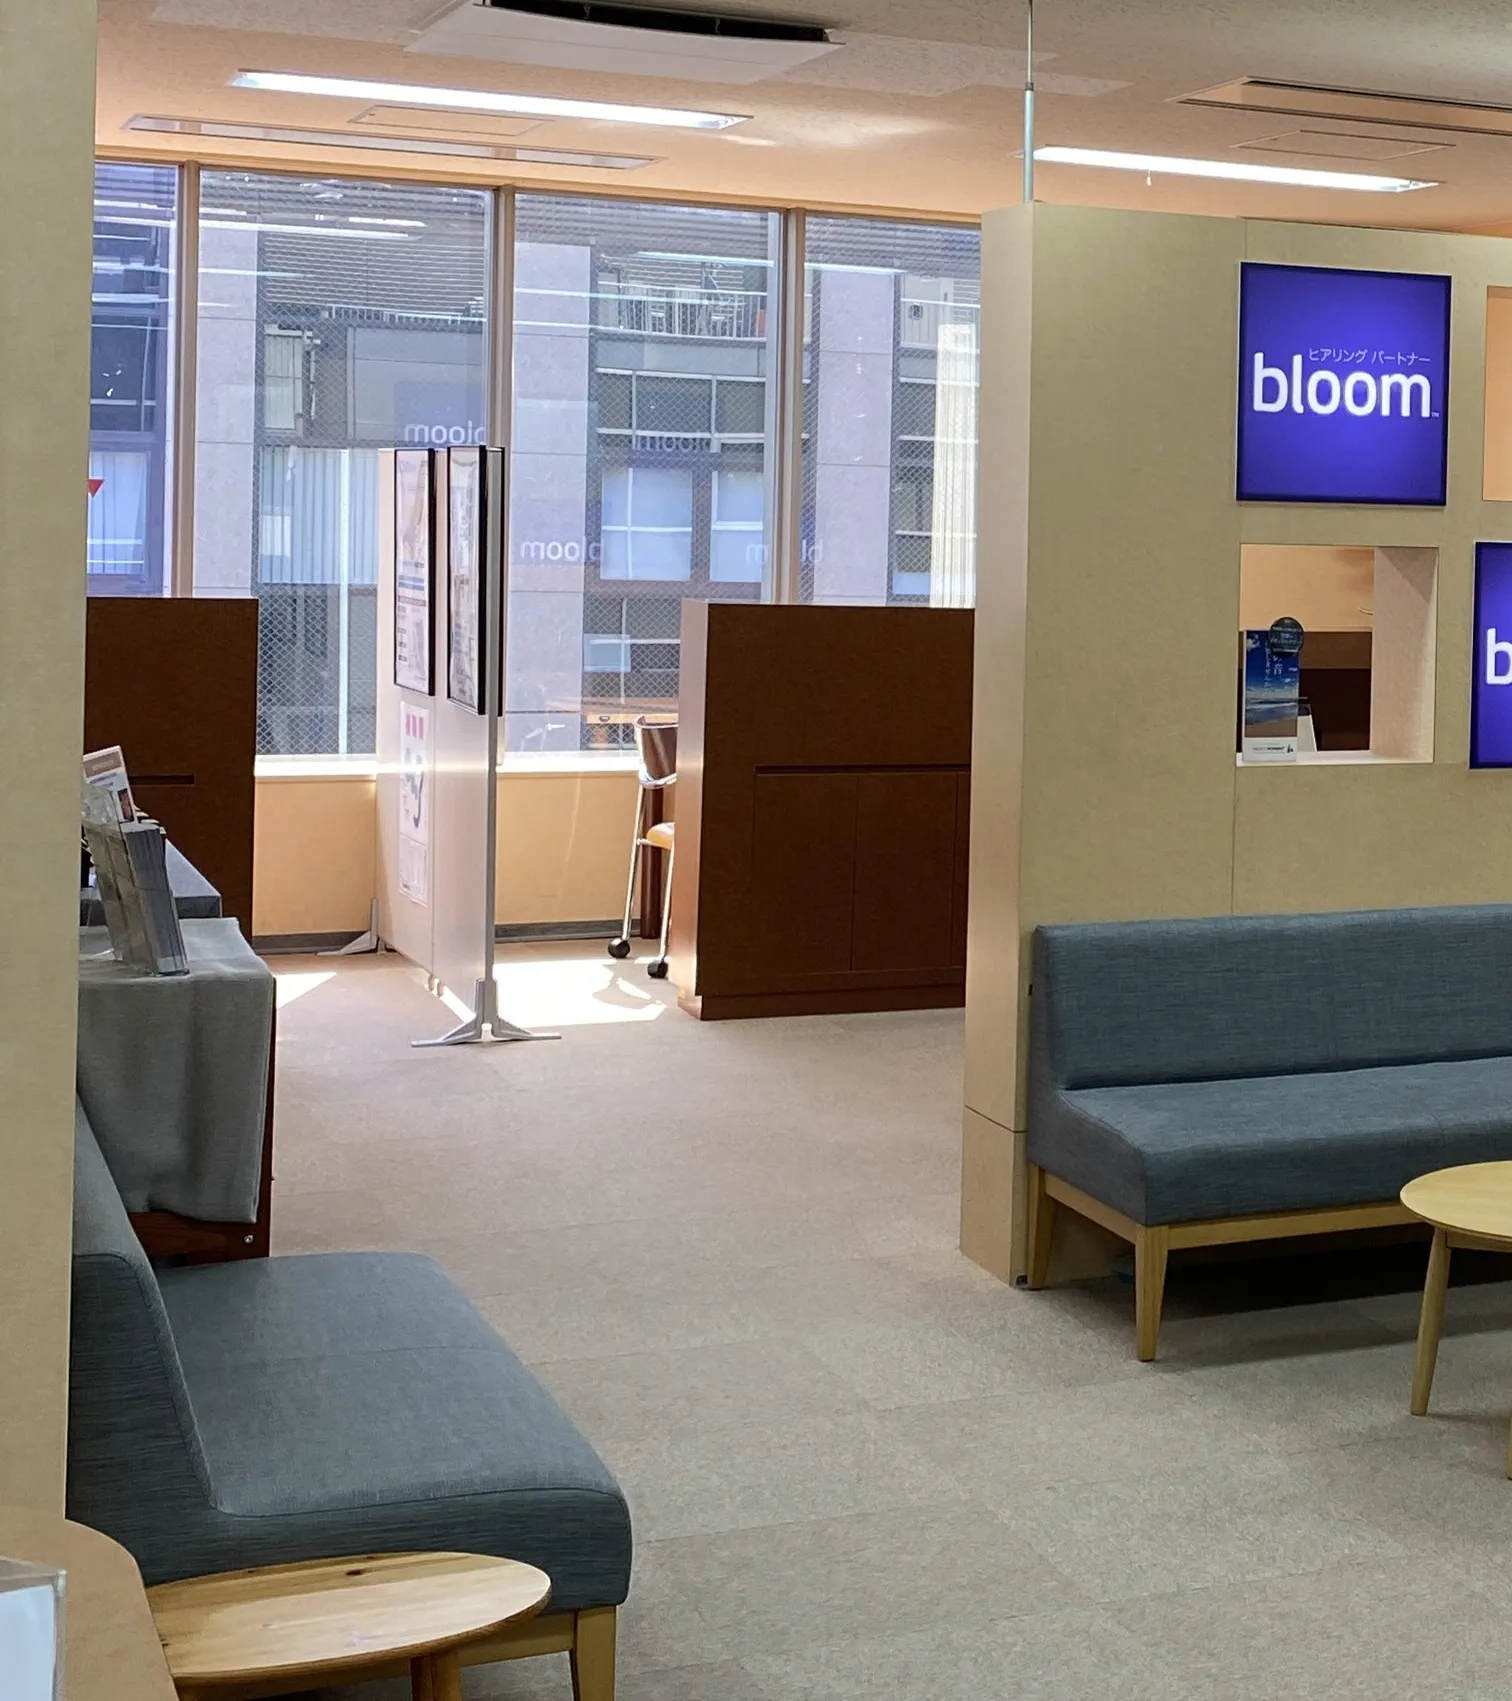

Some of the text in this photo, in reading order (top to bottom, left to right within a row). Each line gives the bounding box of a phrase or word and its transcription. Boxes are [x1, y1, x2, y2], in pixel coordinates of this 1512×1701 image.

[1309, 348, 1431, 366] ヒアリング パートナー
[1253, 352, 1431, 418] bloom
